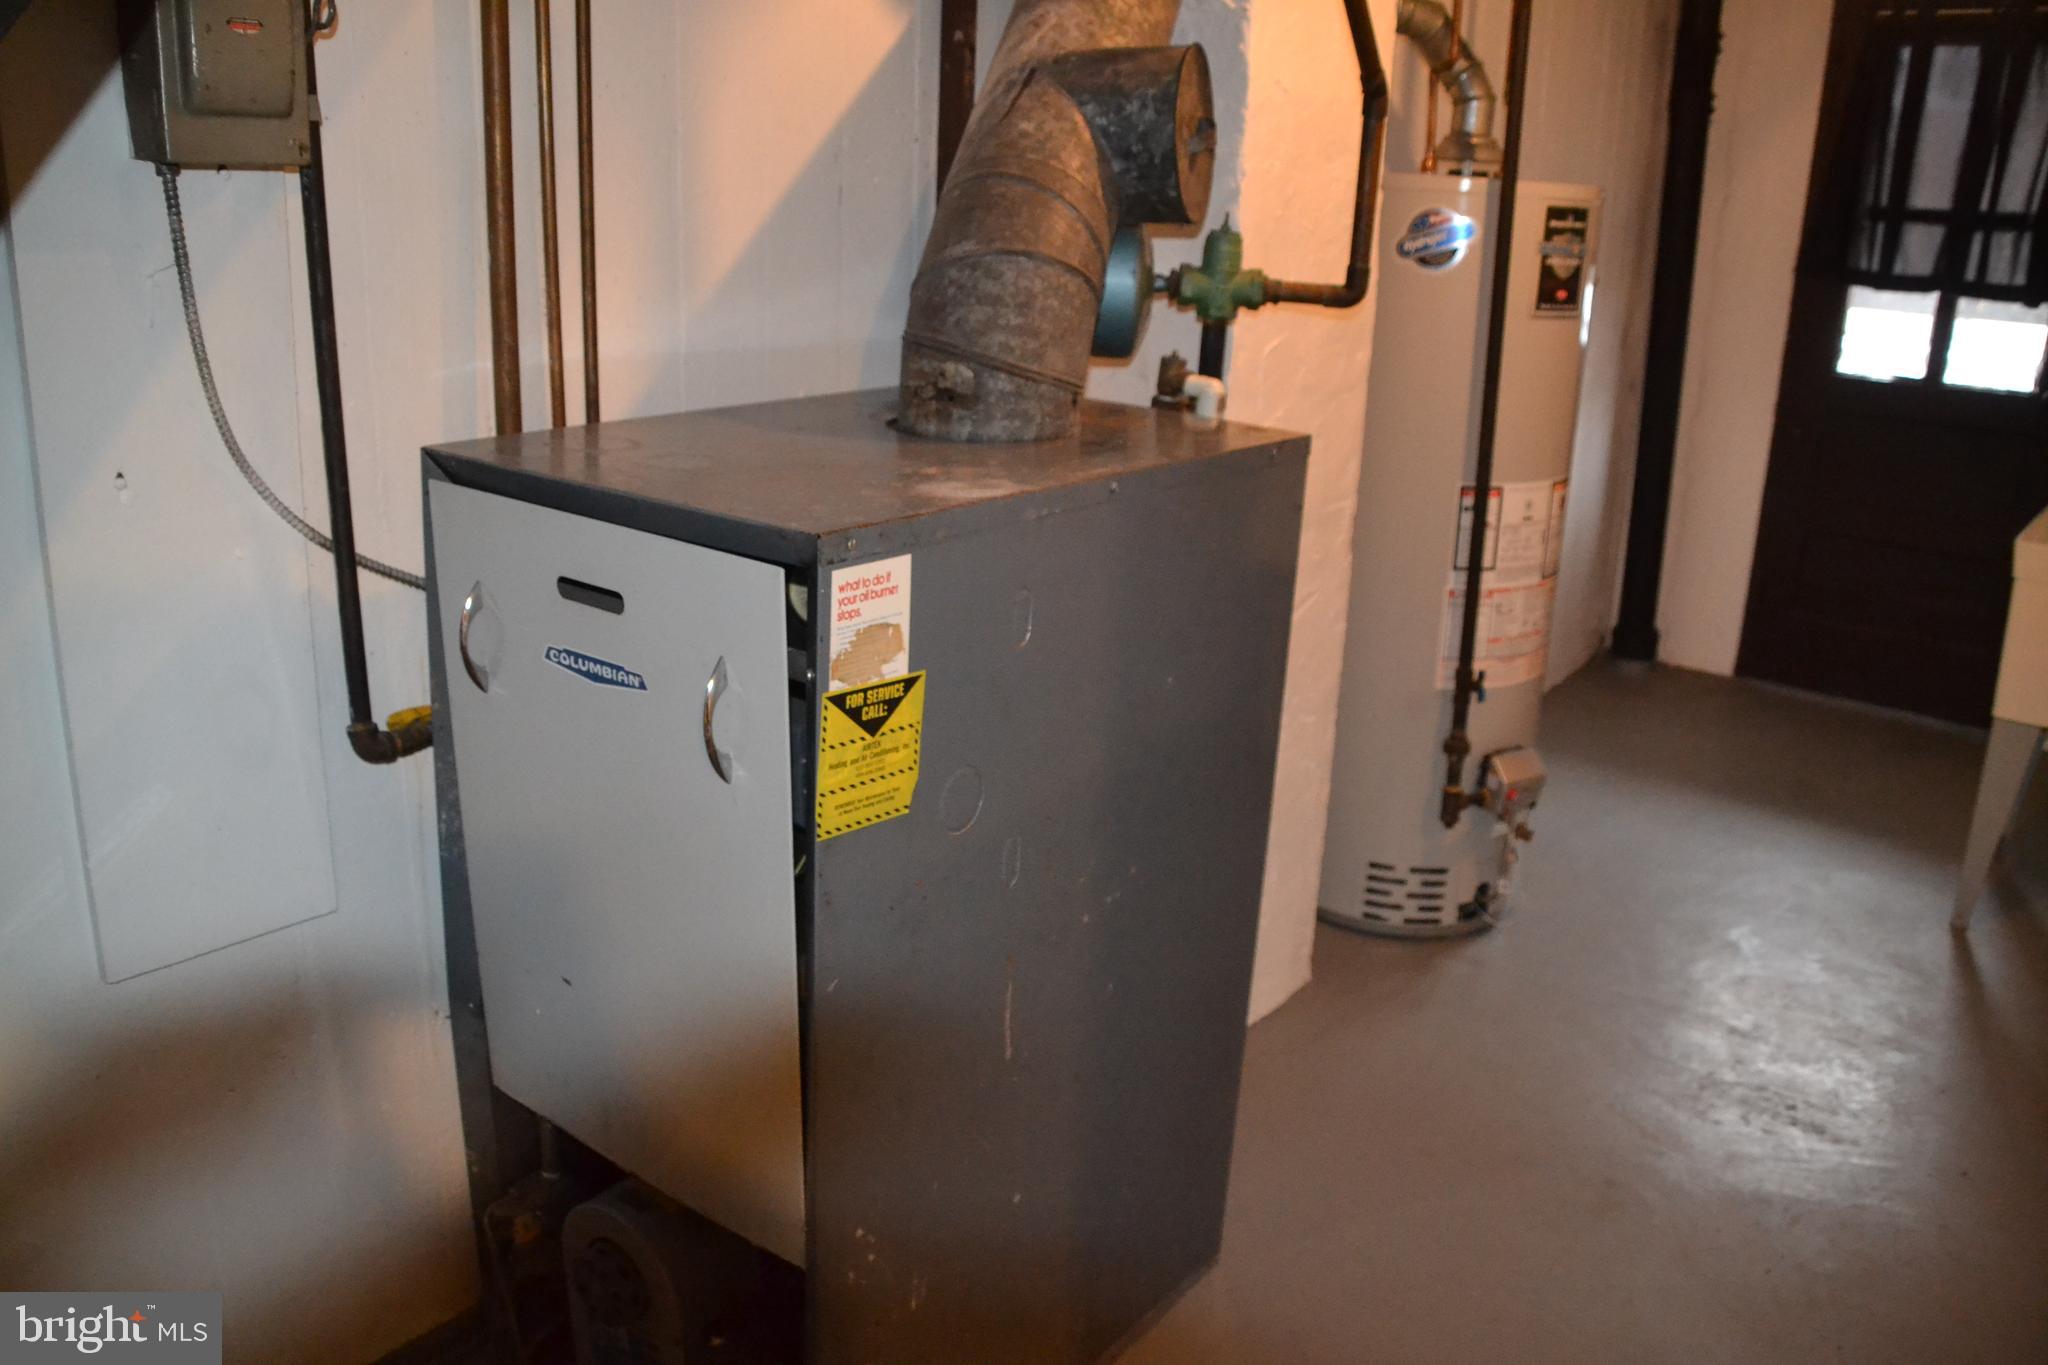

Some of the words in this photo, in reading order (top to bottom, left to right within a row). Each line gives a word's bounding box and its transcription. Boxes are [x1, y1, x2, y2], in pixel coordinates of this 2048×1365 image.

[838, 577, 861, 593] what
[862, 576, 872, 589] to
[872, 573, 886, 586] do
[886, 571, 893, 583] if
[837, 594, 859, 608] your
[859, 590, 870, 603] oil
[870, 584, 900, 600] burner
[837, 607, 863, 622] stops.
[548, 648, 641, 688] COLUMBIAN
[845, 692, 865, 709] FOR
[866, 682, 905, 705] SERVICE
[861, 703, 888, 721] CALL:
